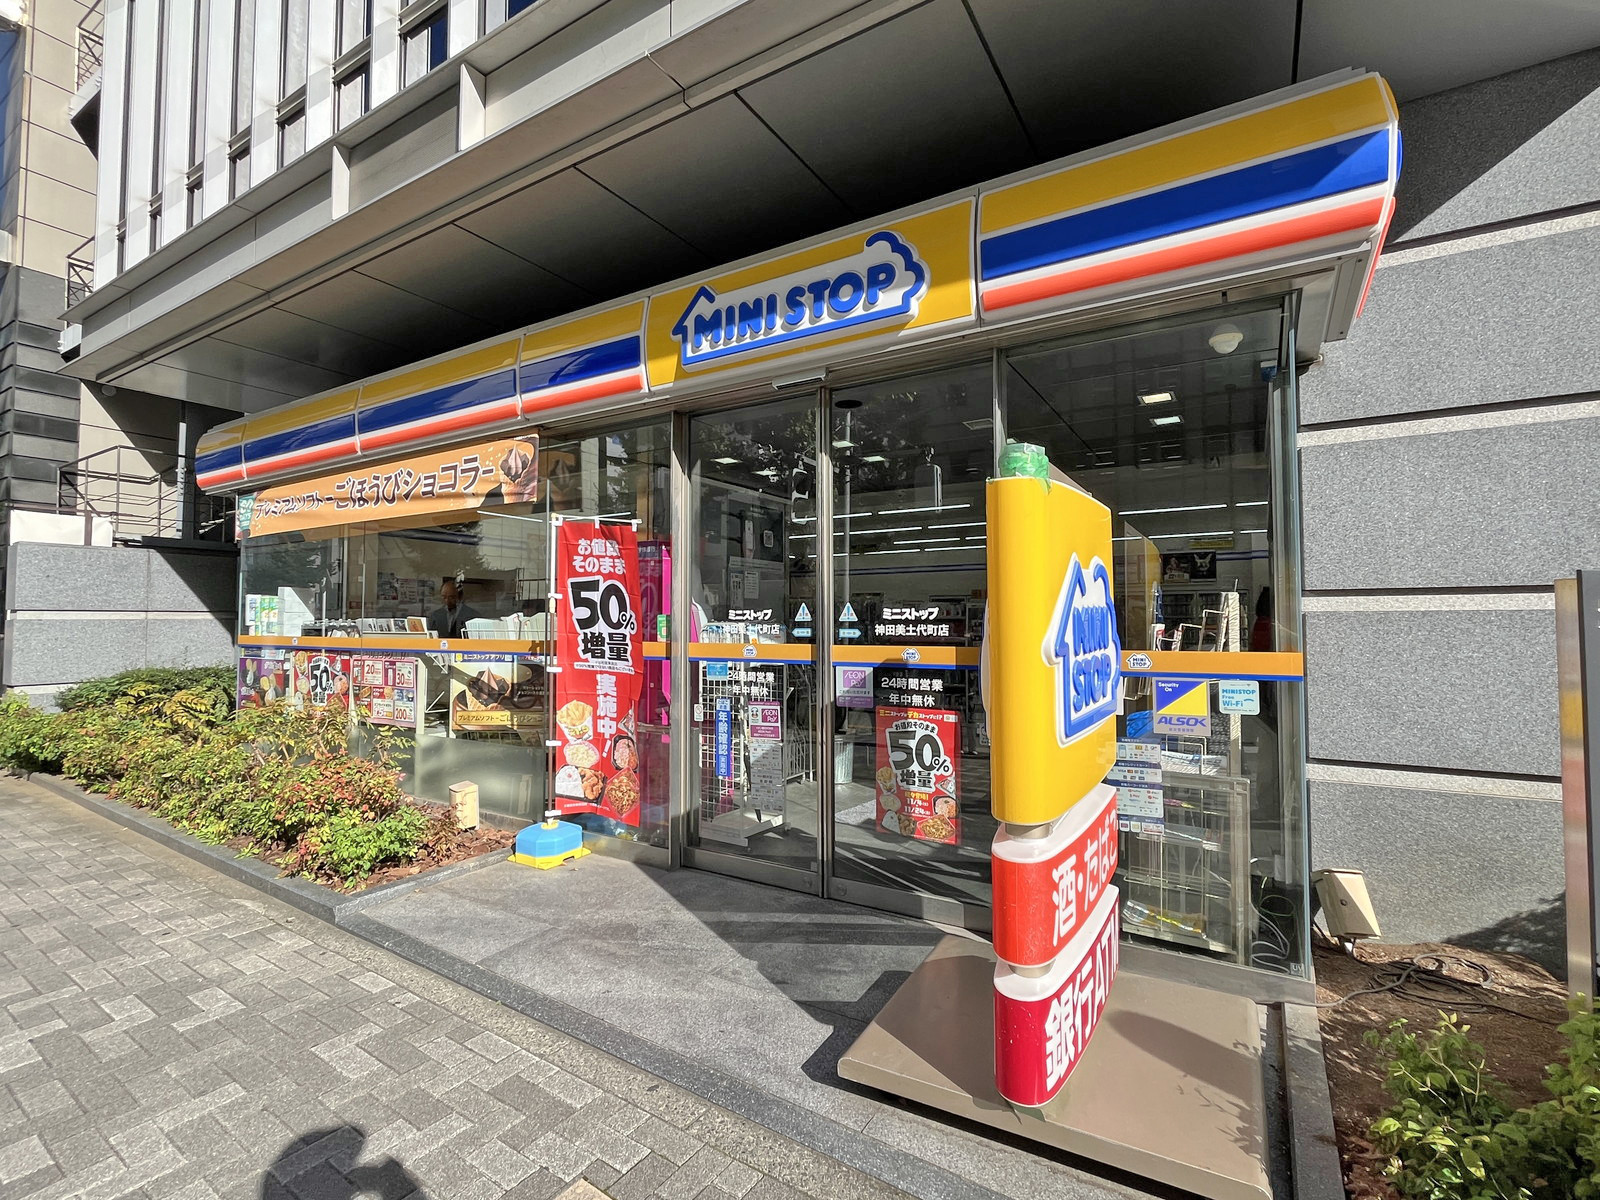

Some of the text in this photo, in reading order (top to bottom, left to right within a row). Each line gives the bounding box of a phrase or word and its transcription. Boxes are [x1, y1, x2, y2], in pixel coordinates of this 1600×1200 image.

[693, 262, 896, 348] MINI STOP
[577, 538, 621, 557] お値段
[572, 555, 627, 575] そのまま
[569, 579, 635, 631] 50%
[882, 607, 940, 620] ミニストップ
[728, 609, 773, 621] ミニストップ
[874, 624, 950, 637] 神田美土代町店
[1072, 606, 1109, 657] MINI
[581, 631, 630, 662] 増量
[727, 672, 775, 683] 24時間営業
[881, 677, 944, 692] 24時間営業
[1072, 653, 1112, 713] STOP
[732, 685, 769, 697] 年中無休
[888, 693, 936, 708] 年中無休
[894, 721, 937, 734] お値段そのまま
[1157, 716, 1207, 727] ALSOK
[888, 730, 950, 772] 50%
[899, 769, 932, 789] 増量
[1045, 902, 1118, 1092] 銀行ATM
